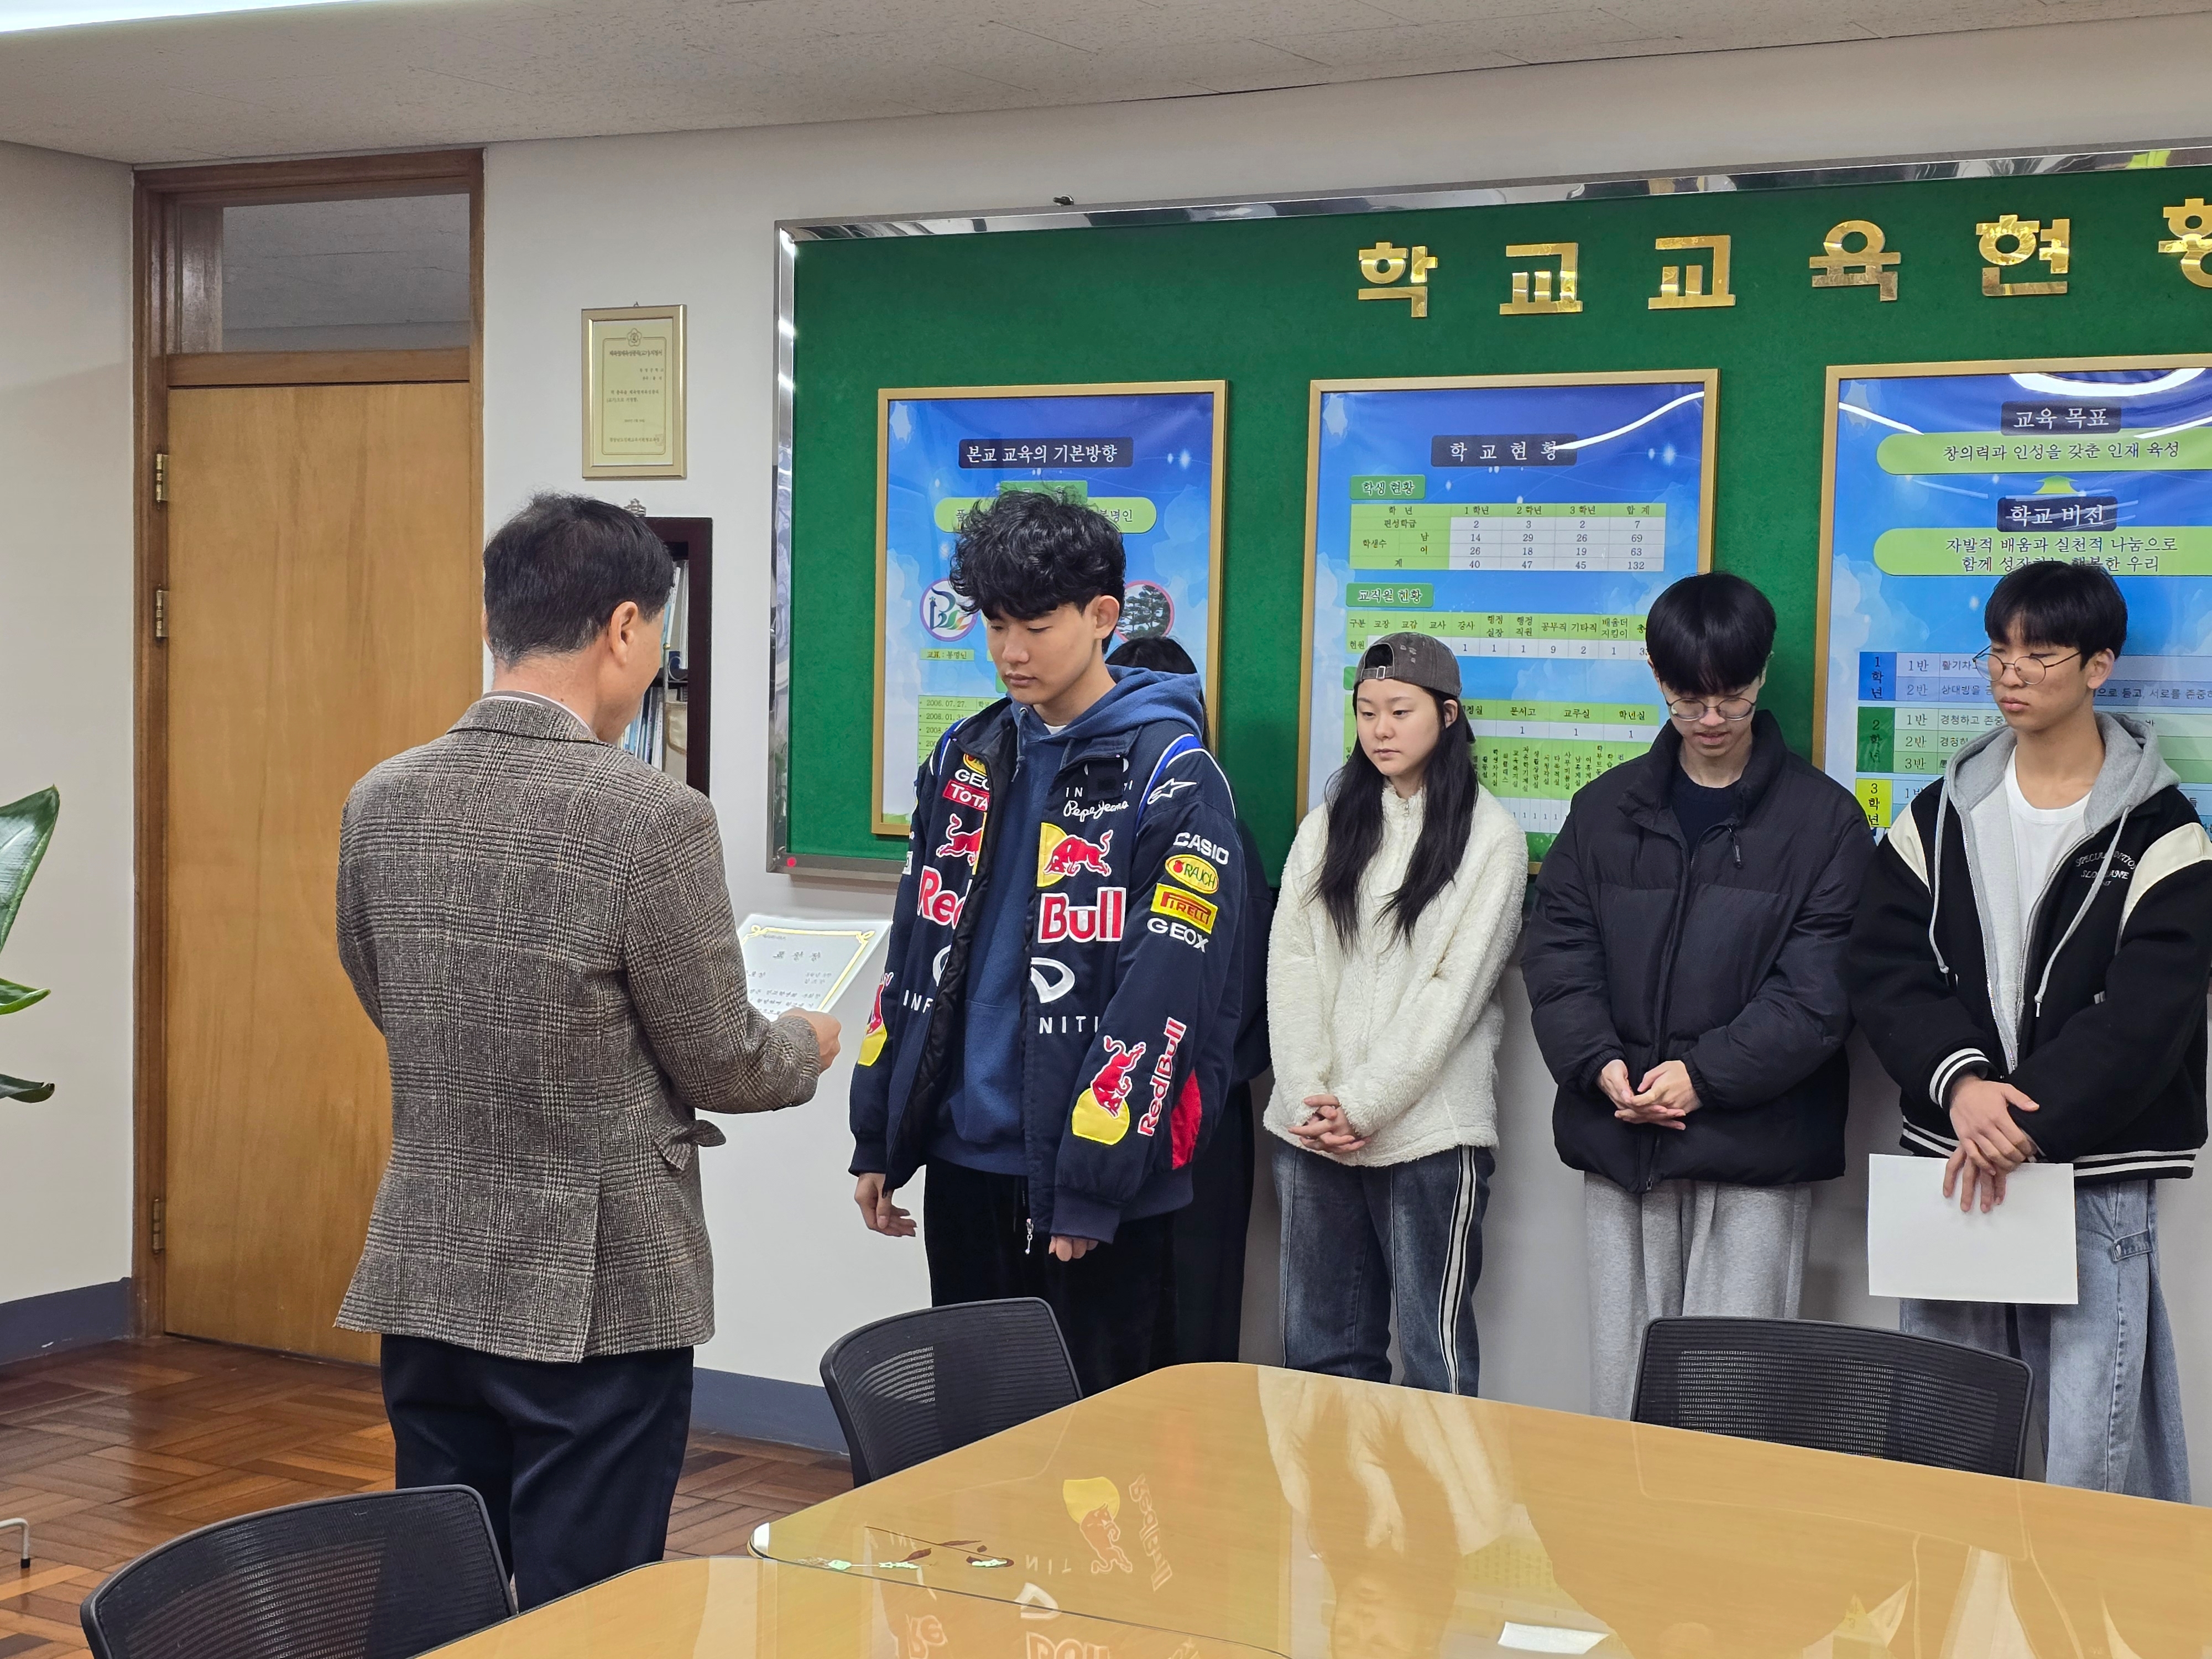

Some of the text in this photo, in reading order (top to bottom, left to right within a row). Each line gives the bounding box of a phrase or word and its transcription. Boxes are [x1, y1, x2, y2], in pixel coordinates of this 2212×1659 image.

[2013, 408, 2109, 429] 교육 목표
[967, 444, 1118, 463] 본교 교육의 기본방향
[1943, 441, 2179, 462] 창의력과 인성을 갖춘 인재 육성
[1363, 482, 1386, 495] 학생
[2010, 505, 2104, 525] 학교 비전
[1526, 520, 1531, 529] 3
[1470, 534, 1480, 542] 14
[1522, 534, 1533, 542] 29
[1631, 534, 1642, 542] 69
[1945, 536, 2178, 552] 자발적 배움과 실천적 나눔으로
[1470, 547, 1480, 555] 26
[1576, 547, 1587, 556] 19
[1627, 561, 1645, 570] 132
[1962, 556, 1992, 572] 함께
[2127, 556, 2159, 572] 우리
[1429, 620, 1446, 629] 교사
[1521, 645, 1526, 653] 1
[1551, 645, 1556, 654] 9
[1580, 646, 1586, 654] 2
[2093, 688, 2117, 697] 으로
[1940, 715, 1980, 725] 경청하고
[1984, 716, 2006, 726] 존중
[1520, 726, 1525, 734] 1
[951, 784, 988, 810] TOTA
[1173, 832, 1229, 865] CASIO
[1184, 863, 1215, 889] RAUCH
[1038, 887, 1126, 943] Bull
[1161, 891, 1212, 925] PIRELLI
[1147, 917, 1209, 953] GEOX
